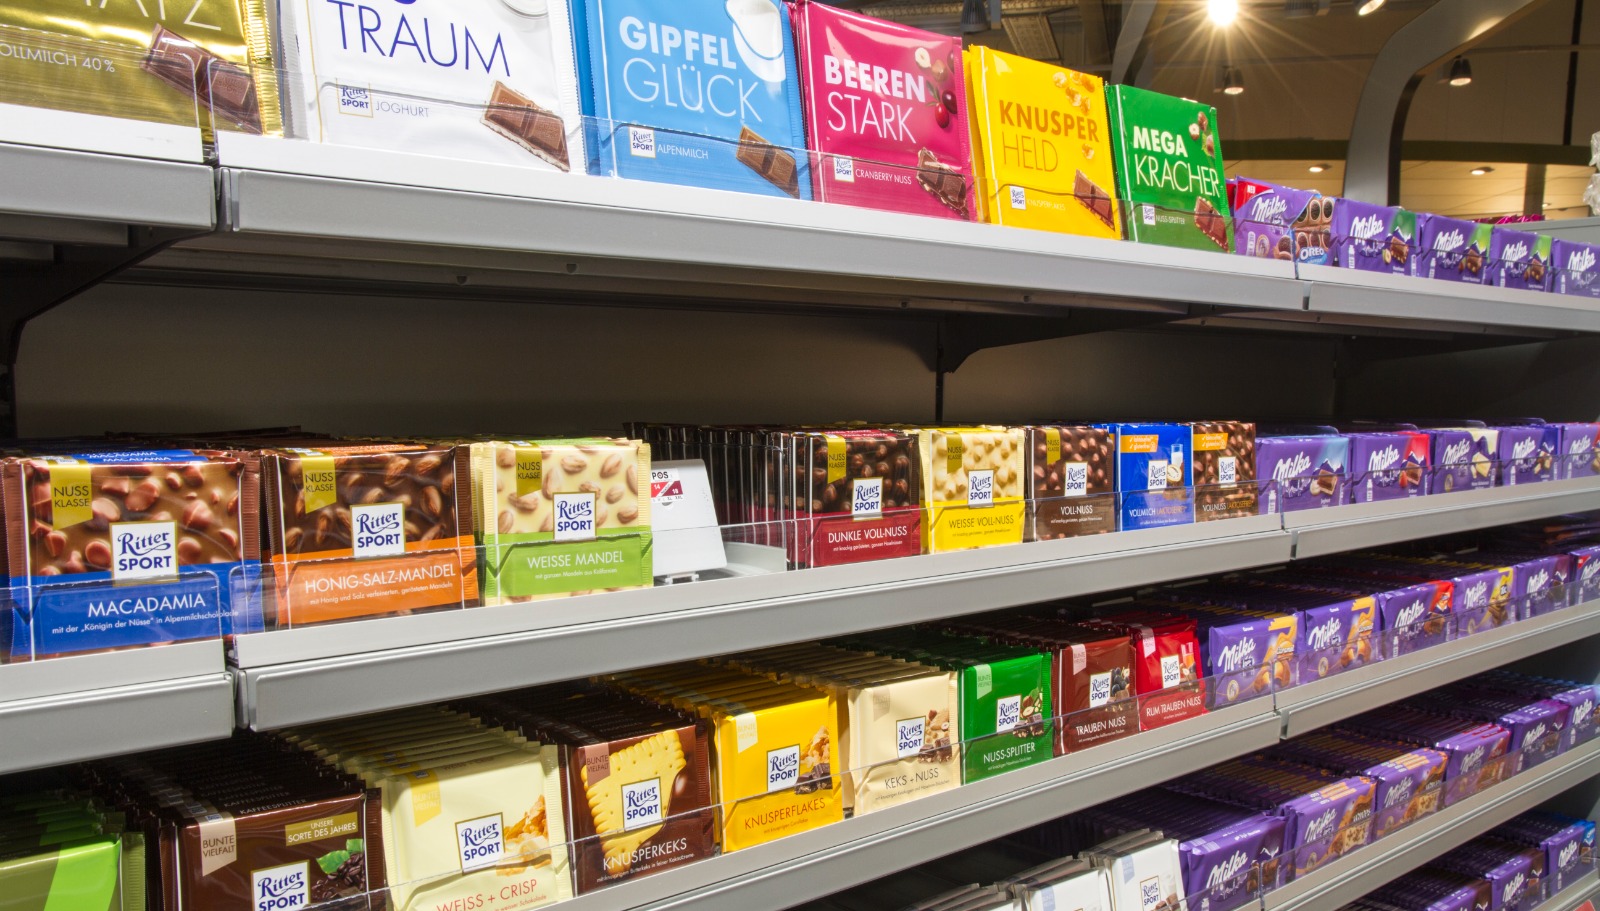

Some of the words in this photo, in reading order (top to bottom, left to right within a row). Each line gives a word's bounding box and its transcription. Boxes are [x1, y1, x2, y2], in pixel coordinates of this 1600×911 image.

[326, 0, 511, 77] TRAUM
[619, 15, 737, 70] GIPFEL
[0, 43, 77, 67] OLLMILCH
[824, 54, 926, 103] BEEREN
[623, 57, 763, 123] GLÜCK
[341, 98, 370, 110] SPORT
[375, 101, 430, 118] JOGHURT
[827, 91, 917, 144] STARK
[999, 99, 1100, 143] KNUSPER
[631, 130, 653, 143] Ritter
[1133, 125, 1188, 158] MEGA
[632, 142, 653, 152] SPORT
[657, 143, 709, 160] ALPENMILCH
[1001, 131, 1059, 173] HELD
[835, 168, 852, 176] SPORT
[855, 168, 893, 182] CRANBERRY
[894, 174, 912, 185] NUSS
[1134, 153, 1221, 199] KRACHER
[1252, 195, 1288, 222] Milka
[1350, 213, 1385, 246] Milka
[1433, 228, 1465, 259] Milka
[1501, 240, 1528, 268] Milka
[1567, 247, 1597, 280] Milka
[828, 453, 846, 461] NUSS
[947, 446, 962, 454] NUSS
[1442, 437, 1471, 470] Milka
[1511, 435, 1537, 466] Milka
[1569, 434, 1592, 461] Milka
[517, 461, 541, 471] NUSS
[829, 461, 846, 469] KLASSE
[1272, 450, 1312, 488] Milka
[1368, 443, 1400, 478] Milka
[305, 472, 334, 483] NUSS
[517, 472, 541, 480] KLASSE
[970, 475, 992, 491] Ritter
[1067, 467, 1086, 480] Ritter
[1149, 478, 1166, 487] SPORT
[1220, 473, 1234, 481] SPORT
[53, 485, 90, 497] NUSS
[305, 484, 334, 493] KLASSE
[855, 484, 880, 501] Ritter
[969, 490, 992, 501] SPORT
[1066, 481, 1086, 490] SPORT
[54, 498, 90, 508] KLASSE
[556, 499, 593, 520] Ritter
[854, 500, 880, 512] SPORT
[1060, 504, 1094, 516] VOLL-NUSS
[1129, 508, 1156, 518] VOLLMILCH
[356, 511, 400, 536] Ritter
[557, 519, 593, 532] SPORT
[948, 517, 975, 529] WEISSE
[976, 514, 1014, 527] VOLL-NUSS
[117, 530, 172, 557] Ritter
[357, 533, 401, 549] SPORT
[828, 530, 862, 543] DUNKLE
[863, 525, 908, 539] VOLL-NUSS
[118, 556, 172, 571] SPORT
[527, 553, 572, 569] WEISSE
[575, 550, 625, 566] MANDEL
[305, 563, 456, 594] HONIG-SALZ-MANDEL
[1526, 568, 1549, 598] Milka
[320, 596, 339, 604] Honig
[1463, 580, 1488, 610] Milka
[87, 593, 206, 618] MACADAMIA
[52, 626, 64, 634] mit
[65, 624, 79, 633] der
[114, 619, 127, 628] der
[1394, 599, 1425, 635] Milka
[1307, 616, 1342, 651] Milka
[1217, 636, 1257, 673] Milka
[1164, 673, 1179, 682] SPORT
[1091, 691, 1109, 701] SPORT
[999, 700, 1019, 717] Ritter
[1146, 706, 1161, 718] RUM
[1160, 699, 1186, 715] TRAUBEN
[1186, 695, 1202, 708] NUSS
[1572, 698, 1593, 725] Milka
[998, 714, 1019, 727] SPORT
[1075, 720, 1107, 736] TRAUBEN
[1108, 715, 1126, 729] NUSS
[898, 722, 923, 741] Ritter
[1522, 722, 1546, 753] Milka
[898, 738, 922, 751] SPORT
[983, 741, 1036, 765] NUSS-SPLITTER
[586, 754, 609, 766] BUNTE
[587, 763, 610, 773] VIELFALT
[769, 752, 798, 773] Ritter
[1460, 744, 1485, 775] Milka
[769, 768, 798, 783] SPORT
[884, 774, 908, 790] KEKS
[915, 767, 939, 783] NUSS
[625, 785, 659, 809] Ritter
[1384, 776, 1413, 808] Milka
[626, 804, 659, 820] SPORT
[744, 797, 826, 830] KNUSPERFLAKES
[287, 831, 312, 843] SORTE
[314, 827, 329, 838] DES
[329, 821, 357, 836] JAHRES
[310, 818, 334, 830] UNSERE
[1304, 808, 1337, 843] Milka
[202, 834, 235, 849] BUNTE
[461, 822, 500, 849] Ritter
[203, 845, 236, 858] VIELFALT
[463, 841, 501, 861] SPORT
[602, 837, 687, 871] KNUSPERKEKS
[1558, 839, 1578, 869] Milka
[1205, 848, 1249, 895] Milka
[257, 871, 305, 900] Ritter
[436, 894, 484, 911] WEISS
[500, 878, 537, 901] CRISP
[1503, 872, 1525, 906] Milka
[258, 892, 305, 911] SPORT
[1143, 893, 1160, 907] SPORT
